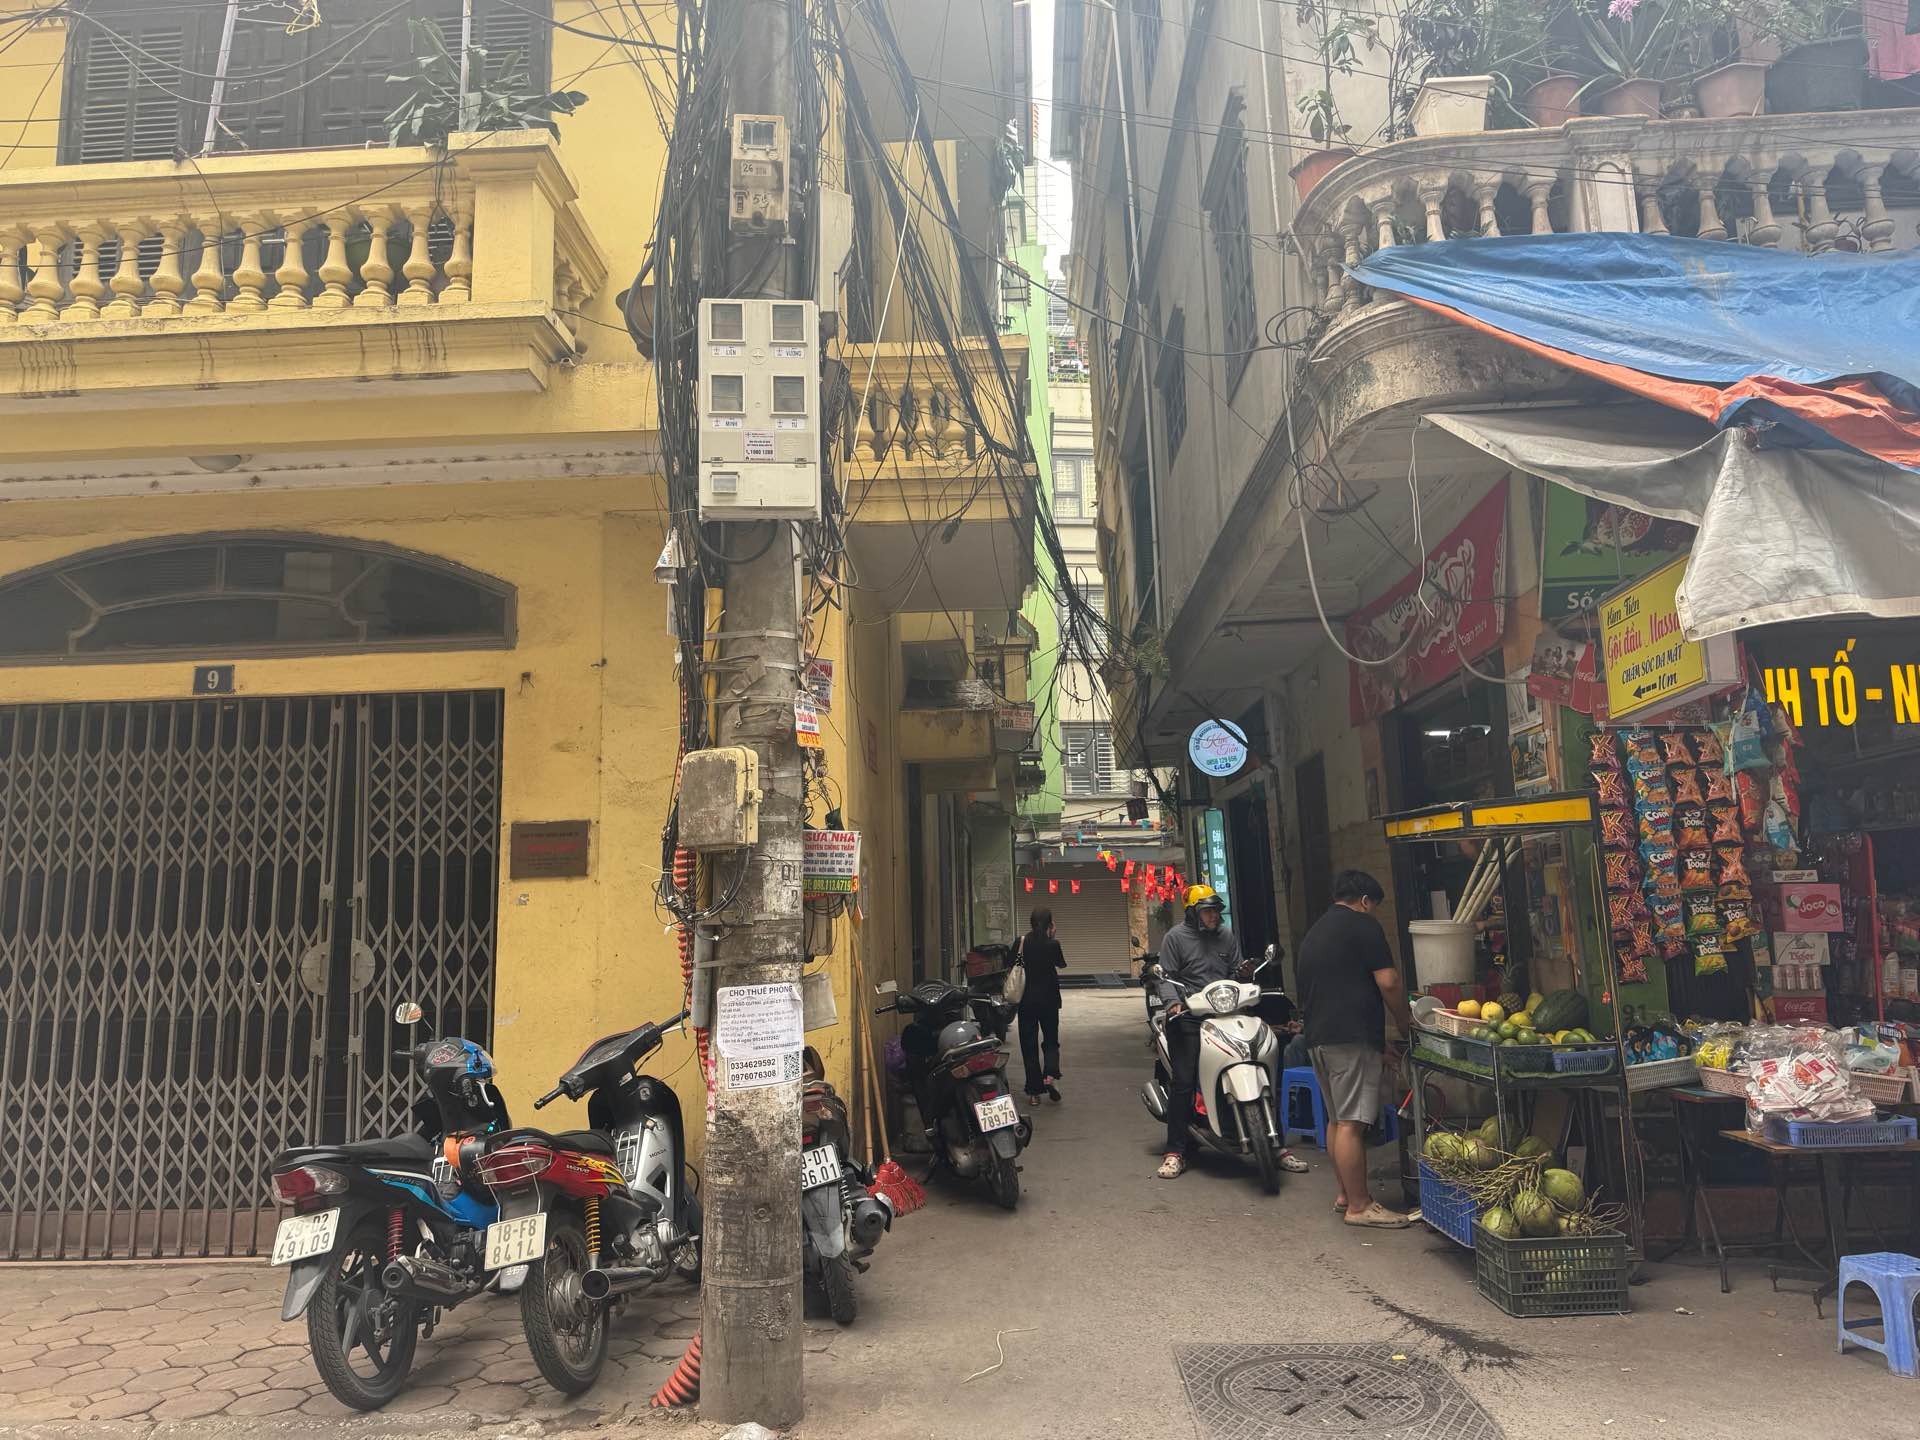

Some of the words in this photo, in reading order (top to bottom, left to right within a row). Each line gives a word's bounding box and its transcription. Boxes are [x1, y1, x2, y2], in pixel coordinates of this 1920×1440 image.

[207, 670, 219, 690] 9
[1809, 637, 1858, 728] TỐ
[1889, 663, 1920, 725] N
[1788, 951, 1816, 963] Tiger
[729, 989, 745, 997] CHO
[730, 1058, 776, 1070] 0334629592
[730, 1070, 777, 1081] 0976076308
[980, 1110, 1016, 1130] 789.79
[496, 1218, 537, 1244] 18-F8
[276, 1231, 331, 1262] 491.09
